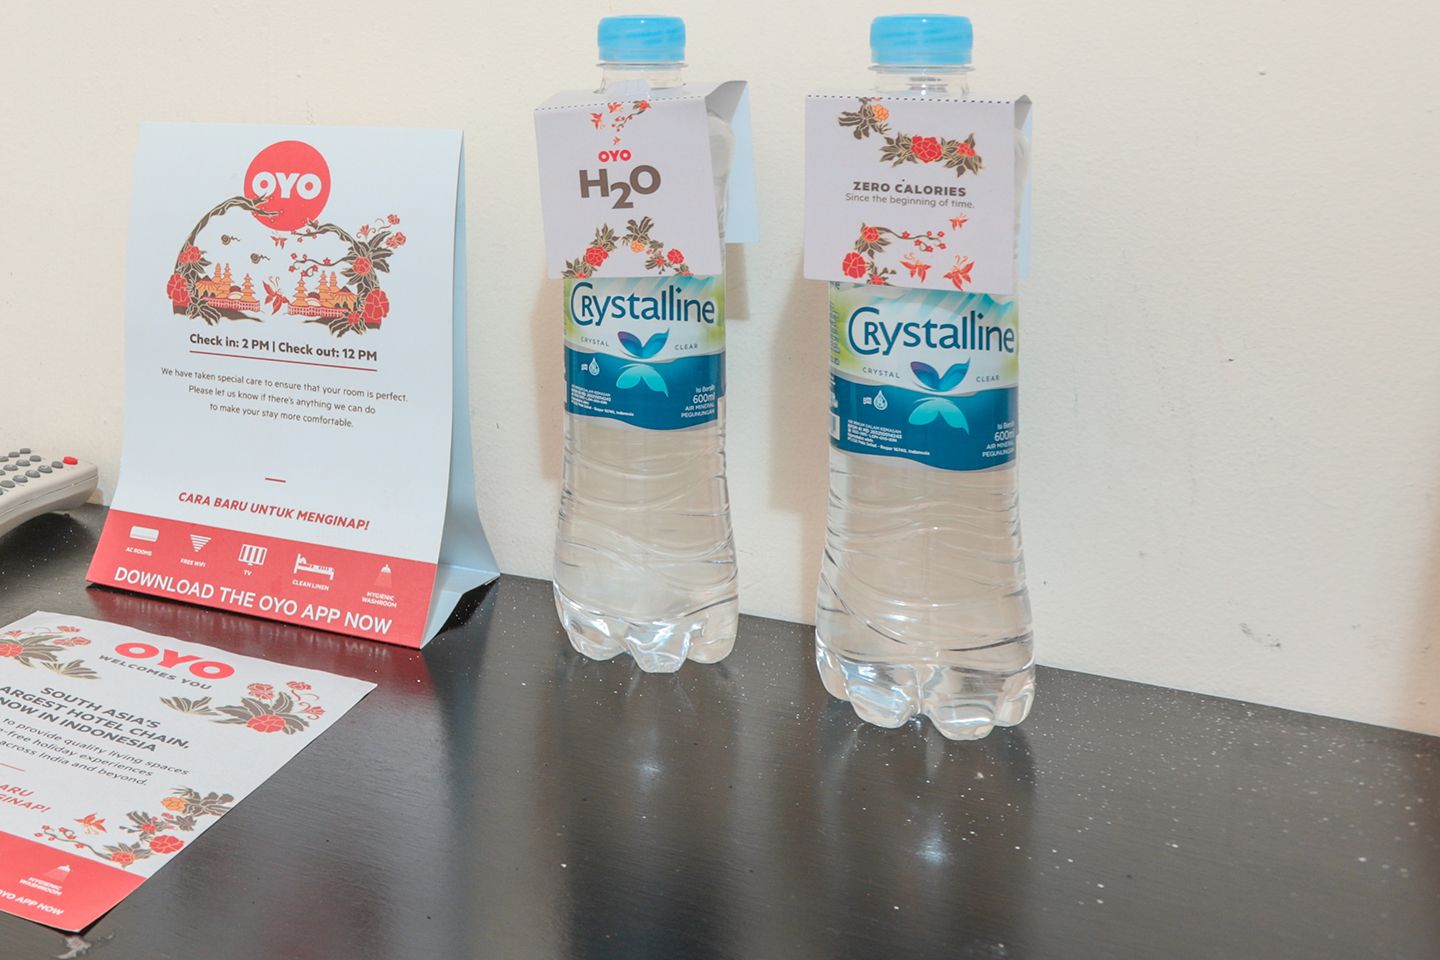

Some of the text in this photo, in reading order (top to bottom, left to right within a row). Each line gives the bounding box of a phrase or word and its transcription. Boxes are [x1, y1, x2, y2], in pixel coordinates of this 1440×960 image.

[598, 149, 632, 162] OYO
[251, 171, 323, 200] OYO
[853, 181, 967, 197] ZERO CALORIES
[845, 192, 975, 209] Since the beginning of time.
[189, 333, 223, 347] Check
[225, 336, 240, 348] in:
[242, 338, 249, 349] 2
[251, 339, 270, 351] PM
[278, 342, 313, 355] Check
[316, 347, 340, 358] out:
[342, 348, 355, 360] 12
[358, 350, 378, 362] PM
[580, 336, 699, 351] CRYSTAL CLEAR
[161, 367, 408, 403] We have taken special care to ensure that your room is perfect.
[862, 366, 1000, 383] CRYSTAL CLEAR
[189, 384, 376, 415] Please let us know if there's anything we can do
[692, 392, 716, 404] 600ml
[210, 403, 354, 428] to make your stay more comfortable.
[178, 491, 371, 531] CARA BARU UNTUK MENGINAP!
[292, 579, 330, 591] CLEAN LINEN
[366, 591, 396, 601] HYGIENIC
[114, 566, 393, 635] DOWNLOAD THE OYO APP NOW
[361, 596, 398, 609] WASHROOM
[98, 654, 213, 690] WELCOMES YOU
[114, 642, 236, 680] OYO
[40, 687, 161, 729] SOUTH ASIA'S
[38, 711, 60, 724] IN
[59, 719, 158, 752] INDONESIA
[66, 707, 124, 732] HOTEL
[128, 726, 190, 750] CHAIN,
[3, 718, 16, 726] to
[15, 723, 62, 741] provide
[64, 738, 107, 755] quality
[108, 750, 144, 765] living
[145, 759, 189, 776] spaces
[33, 738, 78, 756] holiday
[79, 754, 155, 777] experiences
[39, 751, 70, 765] India
[71, 761, 97, 772] and
[97, 768, 148, 786] beyond.
[15, 895, 39, 908] APP
[36, 902, 65, 916] NOW
